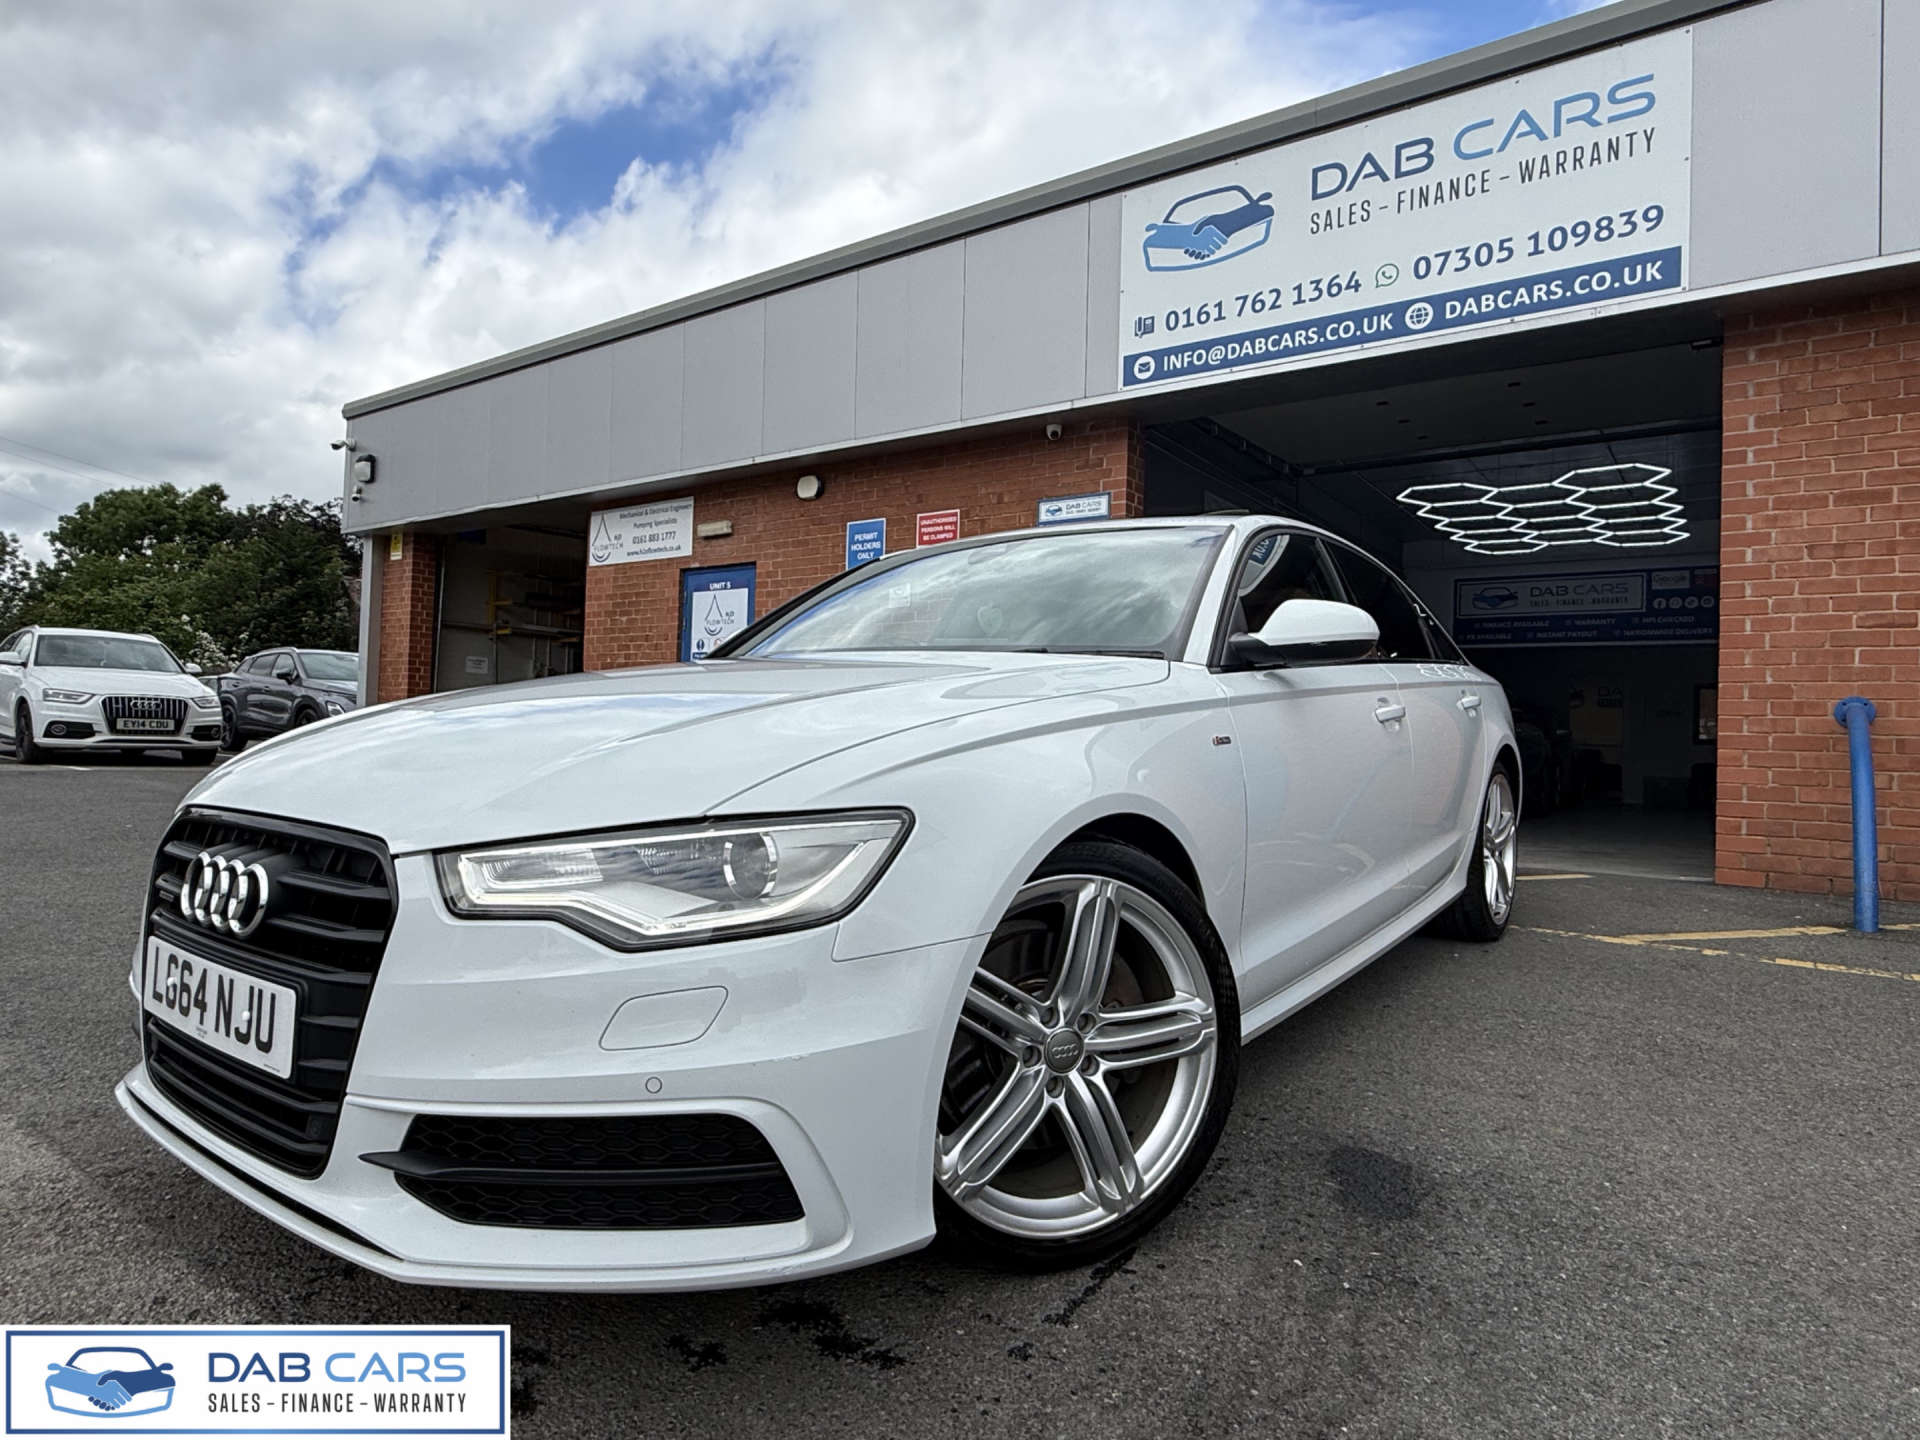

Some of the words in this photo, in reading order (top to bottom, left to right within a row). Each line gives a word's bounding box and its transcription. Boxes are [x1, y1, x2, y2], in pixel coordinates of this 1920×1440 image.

[1311, 137, 1435, 201] DAB
[1453, 73, 1656, 161] CARS
[1310, 199, 1371, 235] SALES
[1397, 169, 1490, 214] FINANCE
[1518, 127, 1656, 184] WARRANTY
[1165, 300, 1226, 332] 0161
[1234, 288, 1282, 317] 762
[1291, 271, 1362, 306] 1364
[1413, 237, 1514, 280] 07305
[1527, 204, 1664, 257] 109839
[1163, 312, 1394, 372] INFO@DABCARS.CO.UK
[1445, 260, 1663, 320] DABCARS.CO.UK
[854, 532, 878, 541] PERMIT
[851, 541, 881, 551] HOLDERS
[857, 552, 875, 560] ONLY
[709, 582, 725, 590] UNIT
[1530, 585, 1569, 598] DAB
[1573, 582, 1629, 596] CARS
[123, 720, 146, 729] EY14
[149, 720, 169, 729] CDU
[152, 946, 208, 1026] LG64
[214, 974, 276, 1054] NJU
